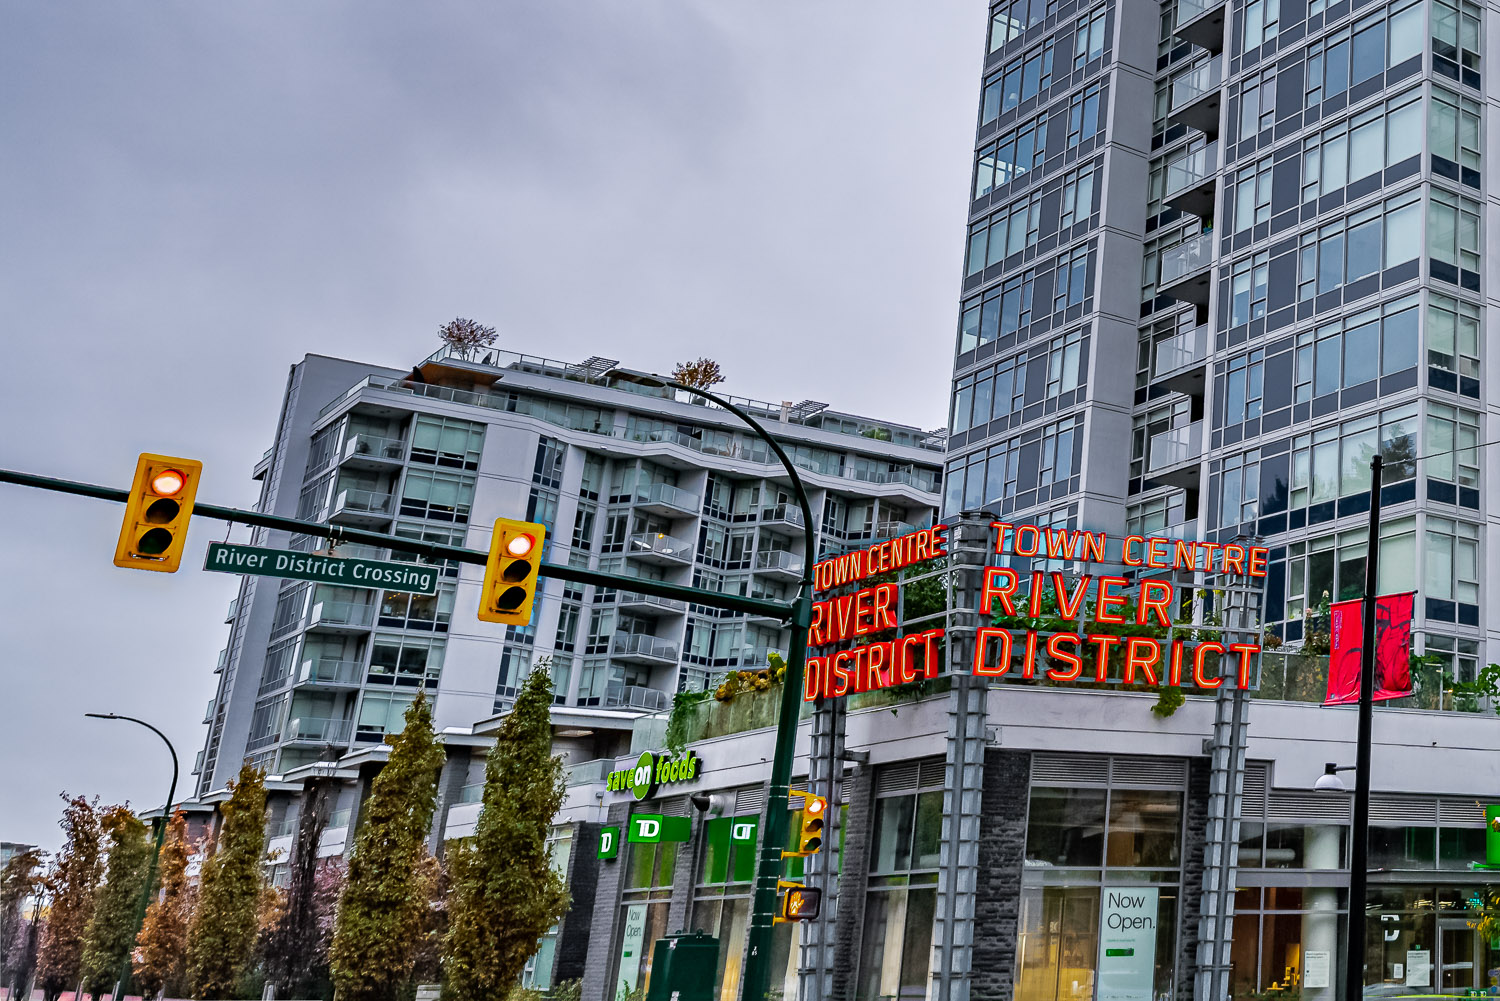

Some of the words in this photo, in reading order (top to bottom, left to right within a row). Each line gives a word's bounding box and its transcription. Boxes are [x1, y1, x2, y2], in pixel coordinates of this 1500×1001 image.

[215, 548, 268, 568] River
[275, 555, 345, 577] District
[352, 563, 431, 590] Crossing
[813, 550, 867, 591] TOWN
[867, 524, 948, 575] CENTRE
[990, 522, 1106, 563] TOWN
[1123, 535, 1269, 577] CENTRE
[807, 583, 898, 647] RIVER
[979, 566, 1174, 627] RIVER
[804, 629, 945, 701] DISTRICT
[972, 627, 1261, 690] DISTRICT
[655, 751, 697, 785] foods
[636, 820, 660, 838] TD
[629, 909, 642, 921] Now
[1107, 912, 1156, 933] Open.
[1108, 892, 1145, 909] Now
